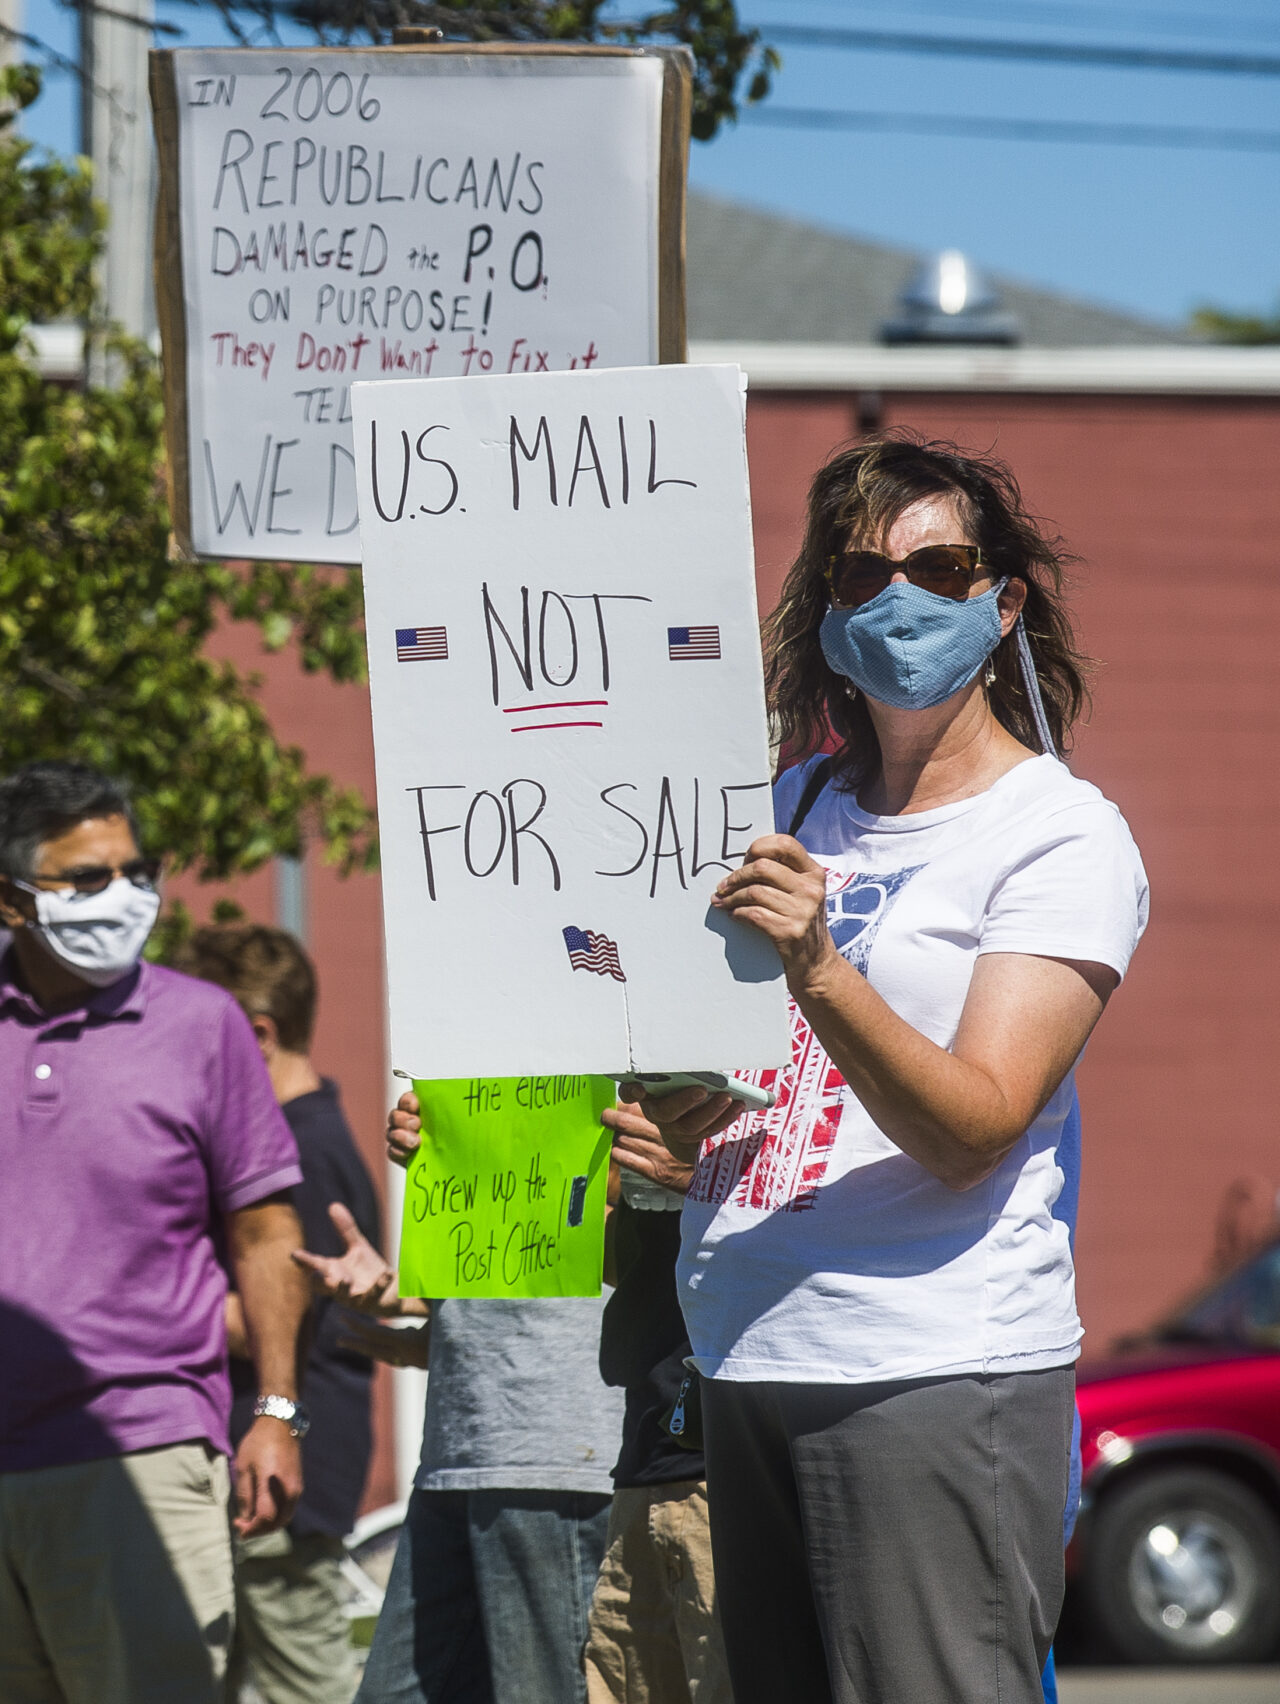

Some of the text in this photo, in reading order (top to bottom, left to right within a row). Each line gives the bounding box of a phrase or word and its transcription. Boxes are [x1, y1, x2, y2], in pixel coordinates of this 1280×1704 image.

[188, 67, 381, 122] IN 2006
[213, 128, 544, 215] REPUBLICANS
[211, 219, 389, 278] DAMAGED
[406, 246, 440, 272] the
[249, 283, 492, 335] ON PURPOSE!
[210, 331, 276, 381] They
[379, 334, 440, 376] Want
[460, 333, 494, 376] to
[506, 338, 551, 374] Fix
[293, 386, 354, 424] TEL
[204, 434, 302, 537] WE
[370, 414, 698, 522] U.S. MAIL
[480, 581, 654, 707] NOT
[404, 776, 771, 902] FOR SALE
[463, 1078, 502, 1117] the
[412, 1152, 547, 1225] Screw up the
[449, 1221, 498, 1287] Post
